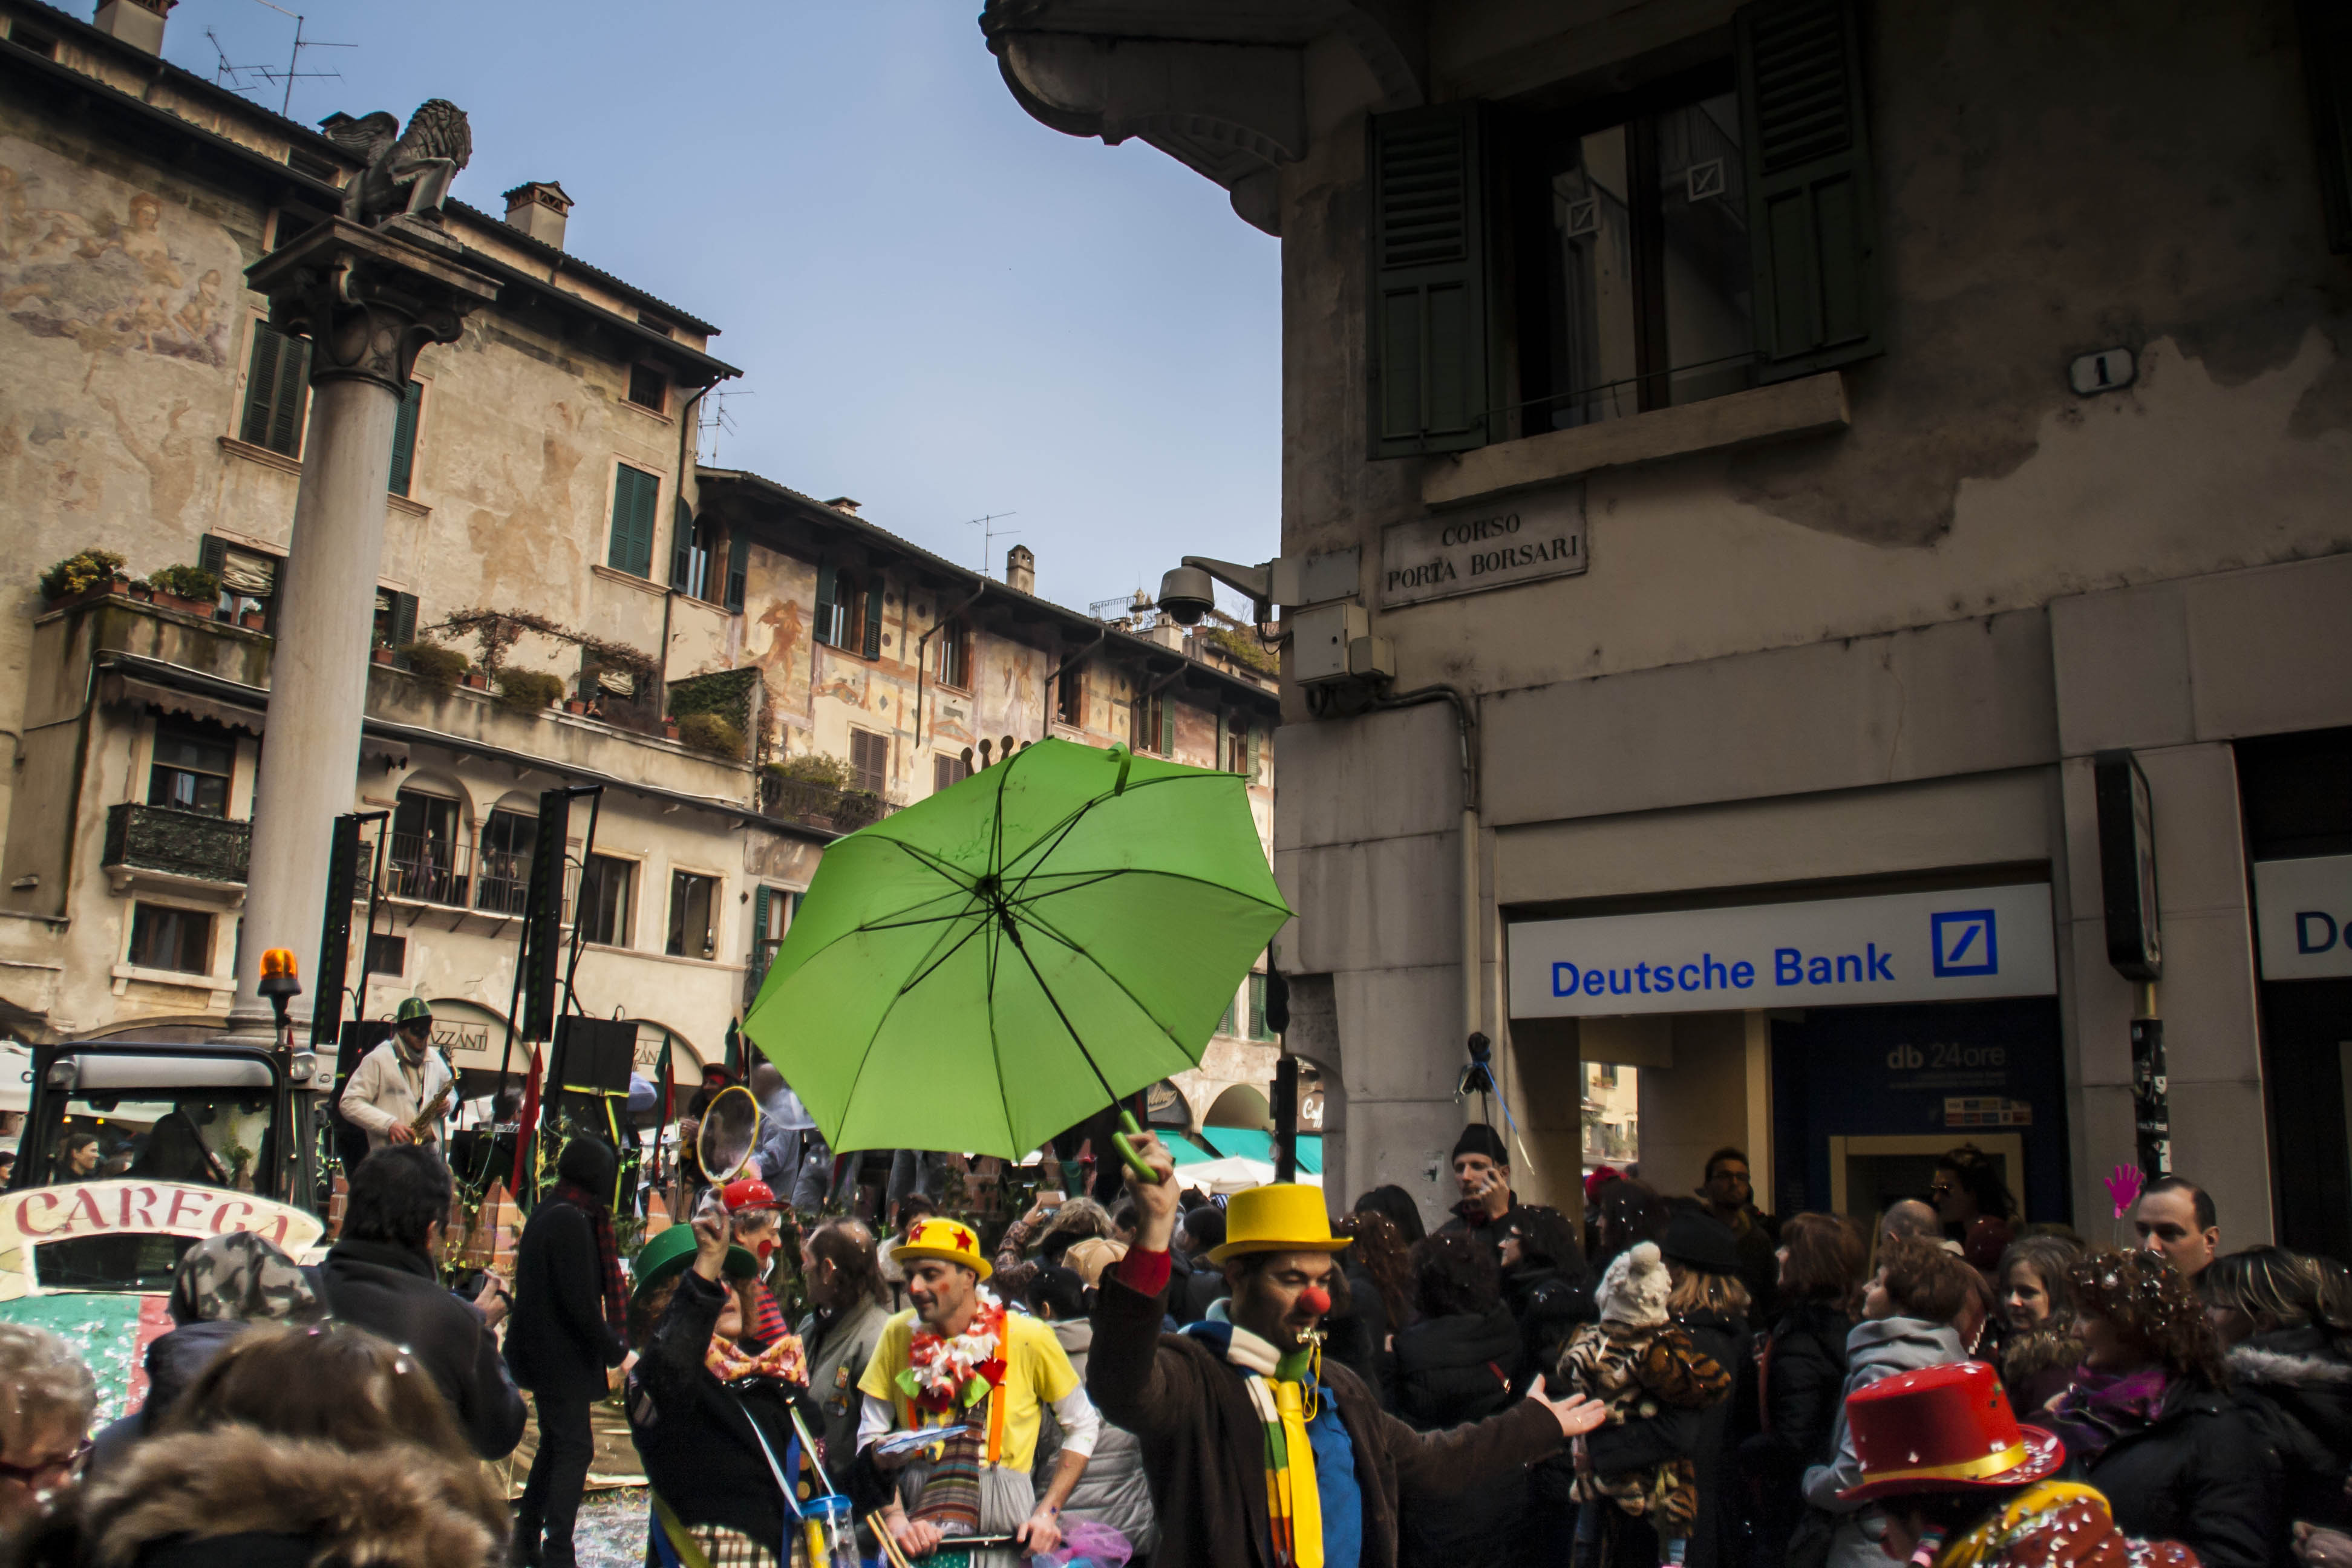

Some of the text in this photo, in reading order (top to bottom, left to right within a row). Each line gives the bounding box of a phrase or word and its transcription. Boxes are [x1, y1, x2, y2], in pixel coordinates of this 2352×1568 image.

[2095, 356, 2111, 386] 1
[1442, 514, 1521, 546] CORSO
[1388, 535, 1578, 592] PORTA BORSARI
[2295, 912, 2352, 954] D
[1552, 942, 1895, 997] Deutsche Bank
[1887, 1042, 2006, 1069] db 24ore
